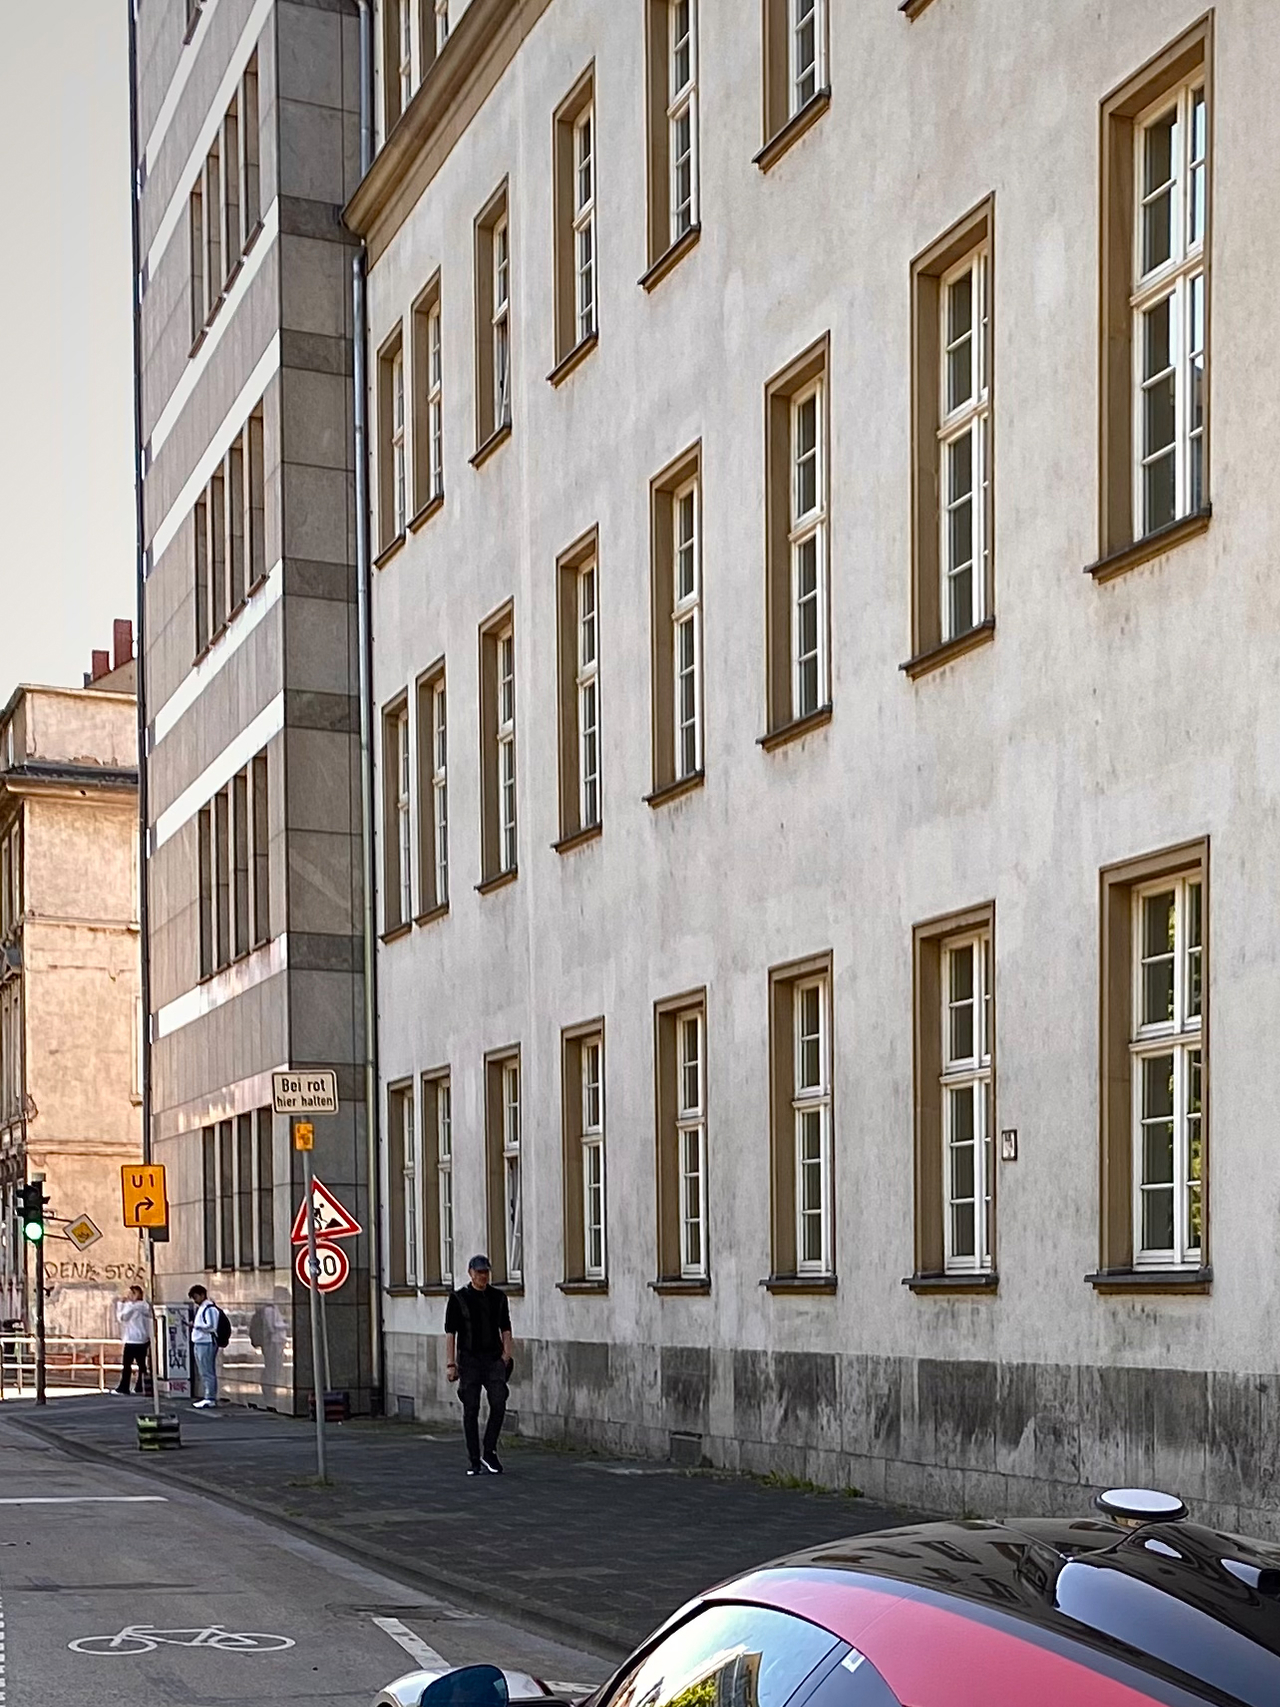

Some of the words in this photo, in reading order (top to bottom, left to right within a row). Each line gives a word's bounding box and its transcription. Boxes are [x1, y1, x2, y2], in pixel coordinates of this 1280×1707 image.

[281, 1077, 302, 1092] Bei
[307, 1078, 326, 1092] rot
[276, 1095, 296, 1107] hier
[301, 1094, 333, 1107] halten
